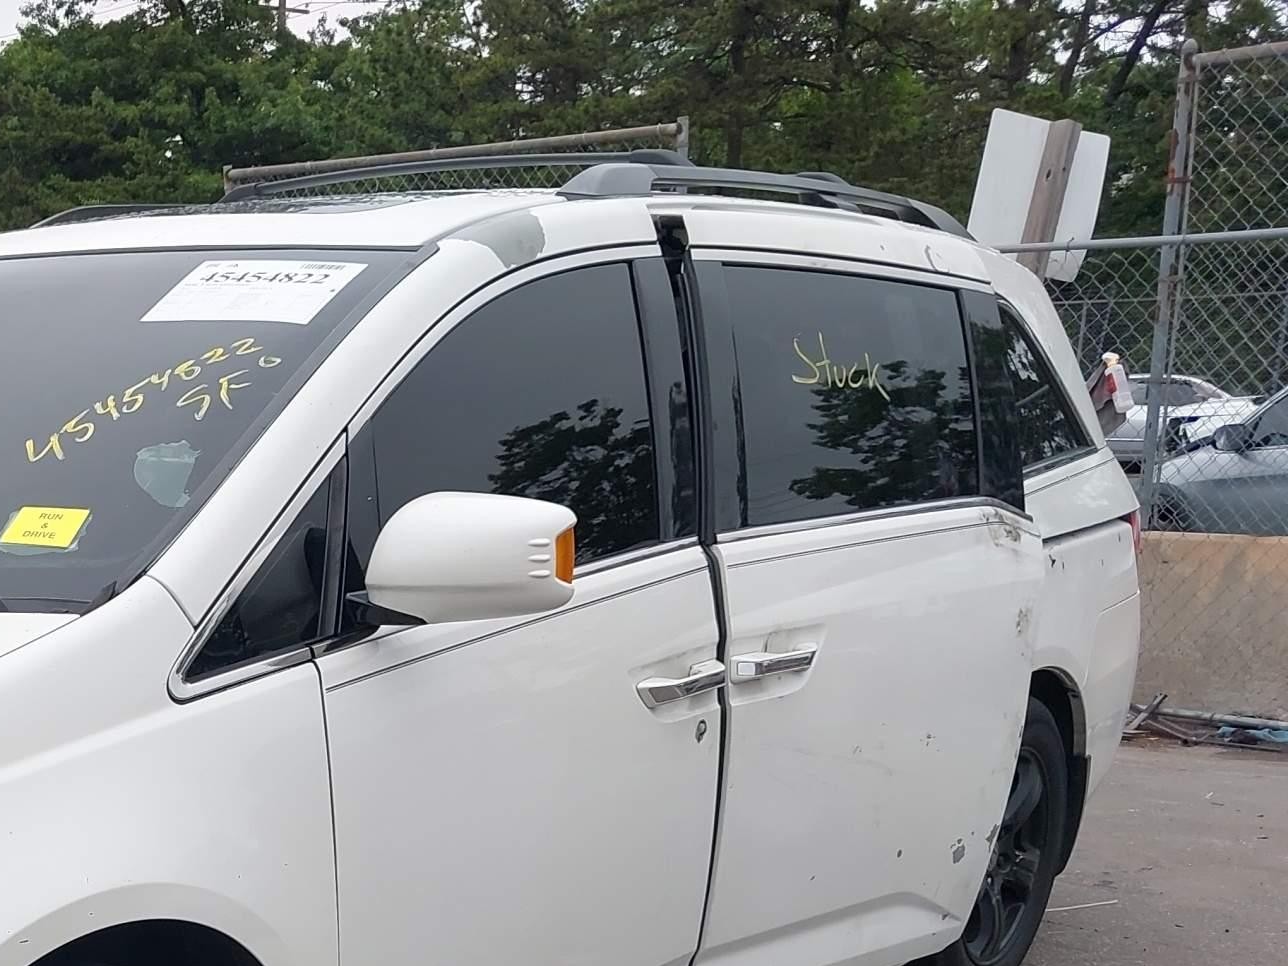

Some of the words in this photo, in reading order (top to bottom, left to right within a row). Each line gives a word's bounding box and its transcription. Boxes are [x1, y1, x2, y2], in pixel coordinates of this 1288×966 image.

[199, 271, 331, 285] 45454822
[791, 331, 891, 402] Stuck
[38, 512, 64, 521] RUN
[22, 530, 57, 540] DRIVE
